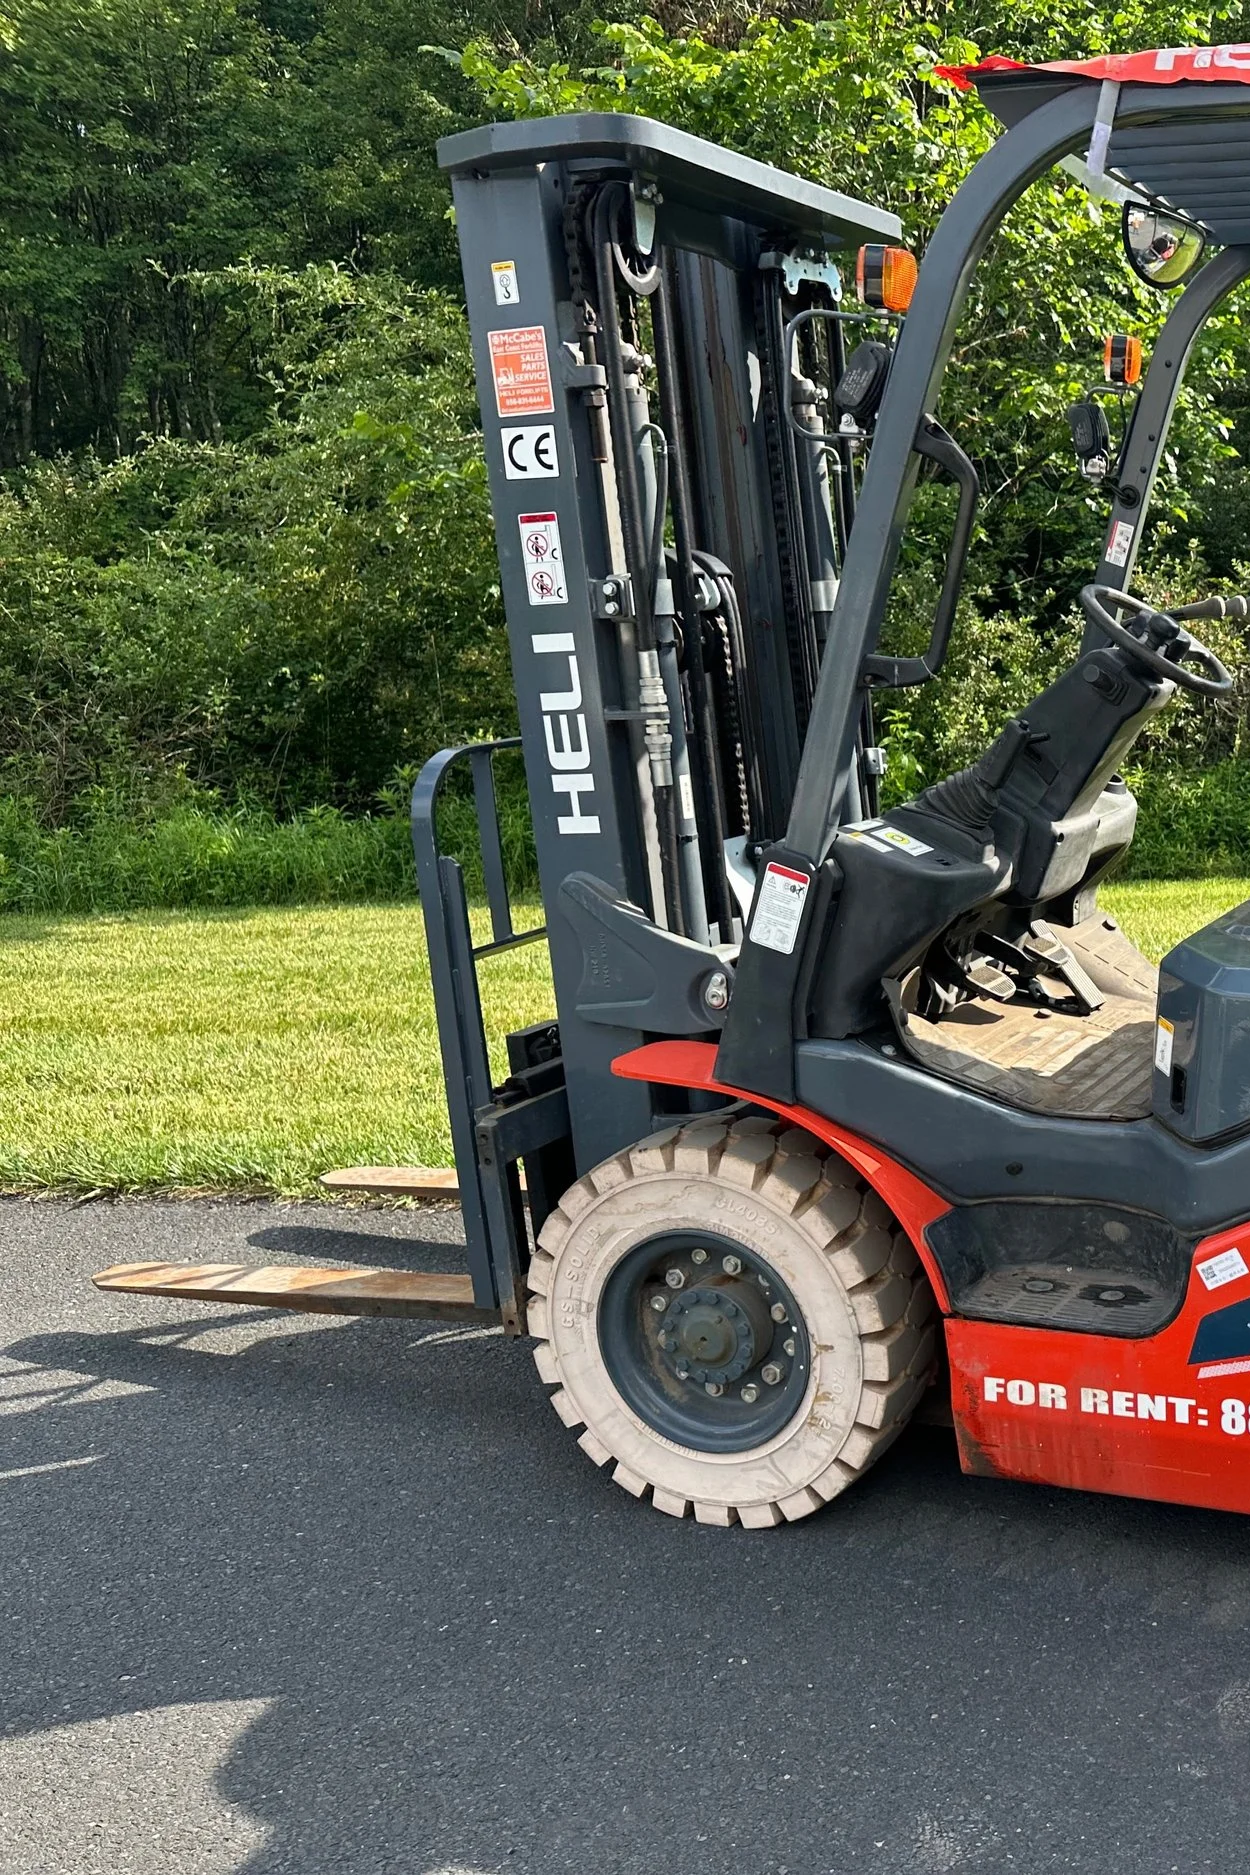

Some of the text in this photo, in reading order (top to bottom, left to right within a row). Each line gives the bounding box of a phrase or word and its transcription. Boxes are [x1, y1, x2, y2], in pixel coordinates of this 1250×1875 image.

[500, 332, 543, 344] McCabe's
[521, 352, 544, 362] SALES
[521, 361, 545, 371] PARTS
[515, 371, 546, 381] SERVICE
[531, 632, 601, 835] HELI
[561, 1225, 600, 1328] GS-SOLID
[983, 1376, 1067, 1410] FOR
[1080, 1387, 1209, 1427] RENT:
